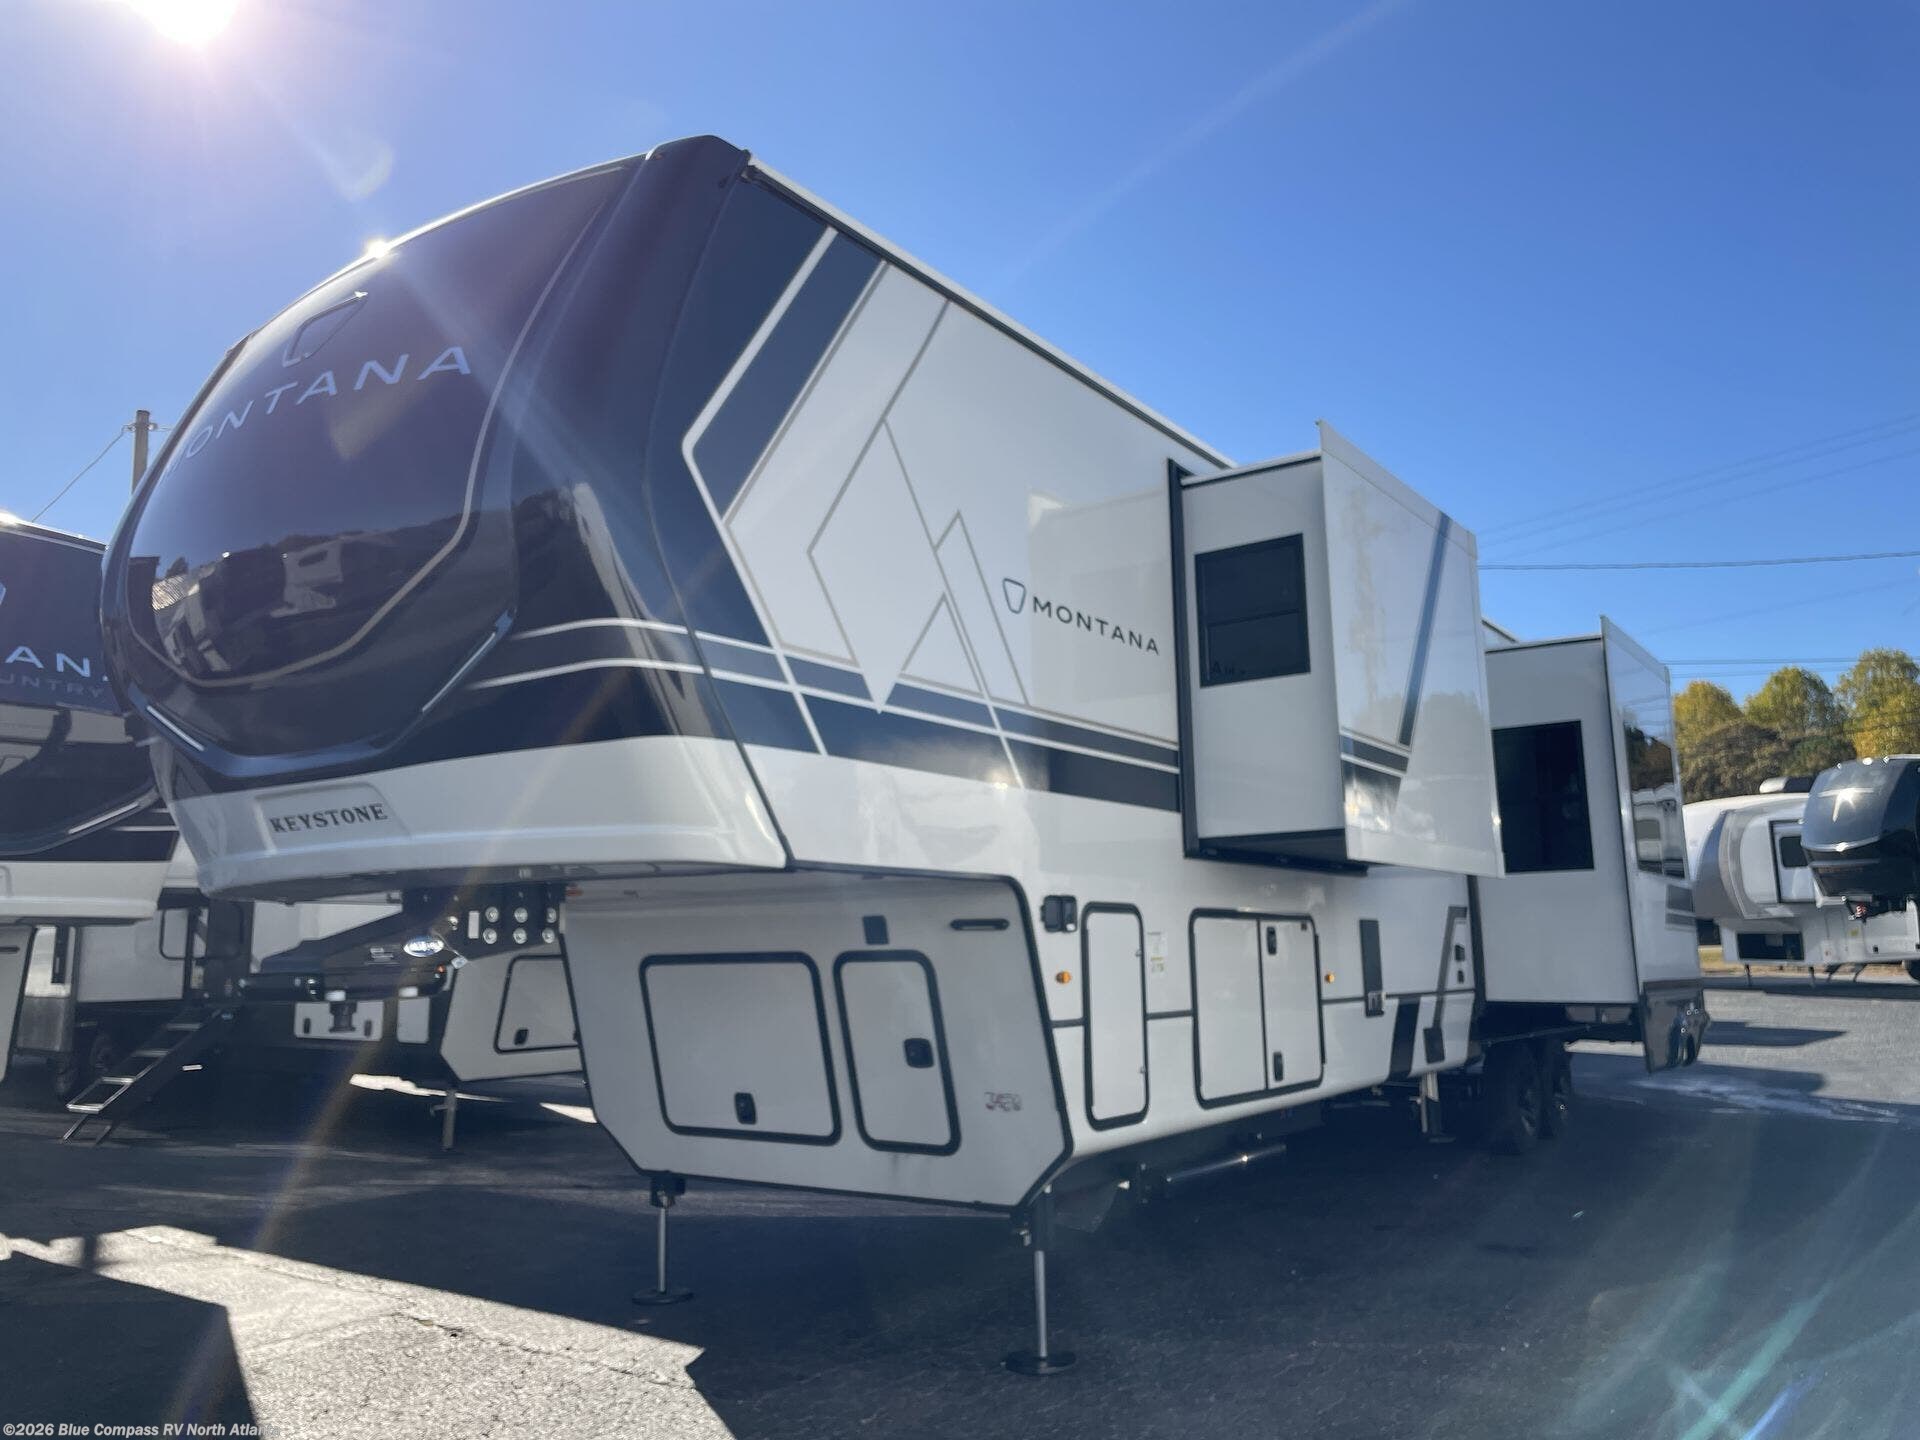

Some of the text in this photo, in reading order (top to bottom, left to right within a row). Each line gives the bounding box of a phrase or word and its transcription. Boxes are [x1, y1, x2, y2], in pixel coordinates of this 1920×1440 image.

[1032, 596, 1160, 656] MONTANA
[5, 646, 108, 681] AN
[269, 803, 388, 833] KEYSTONE
